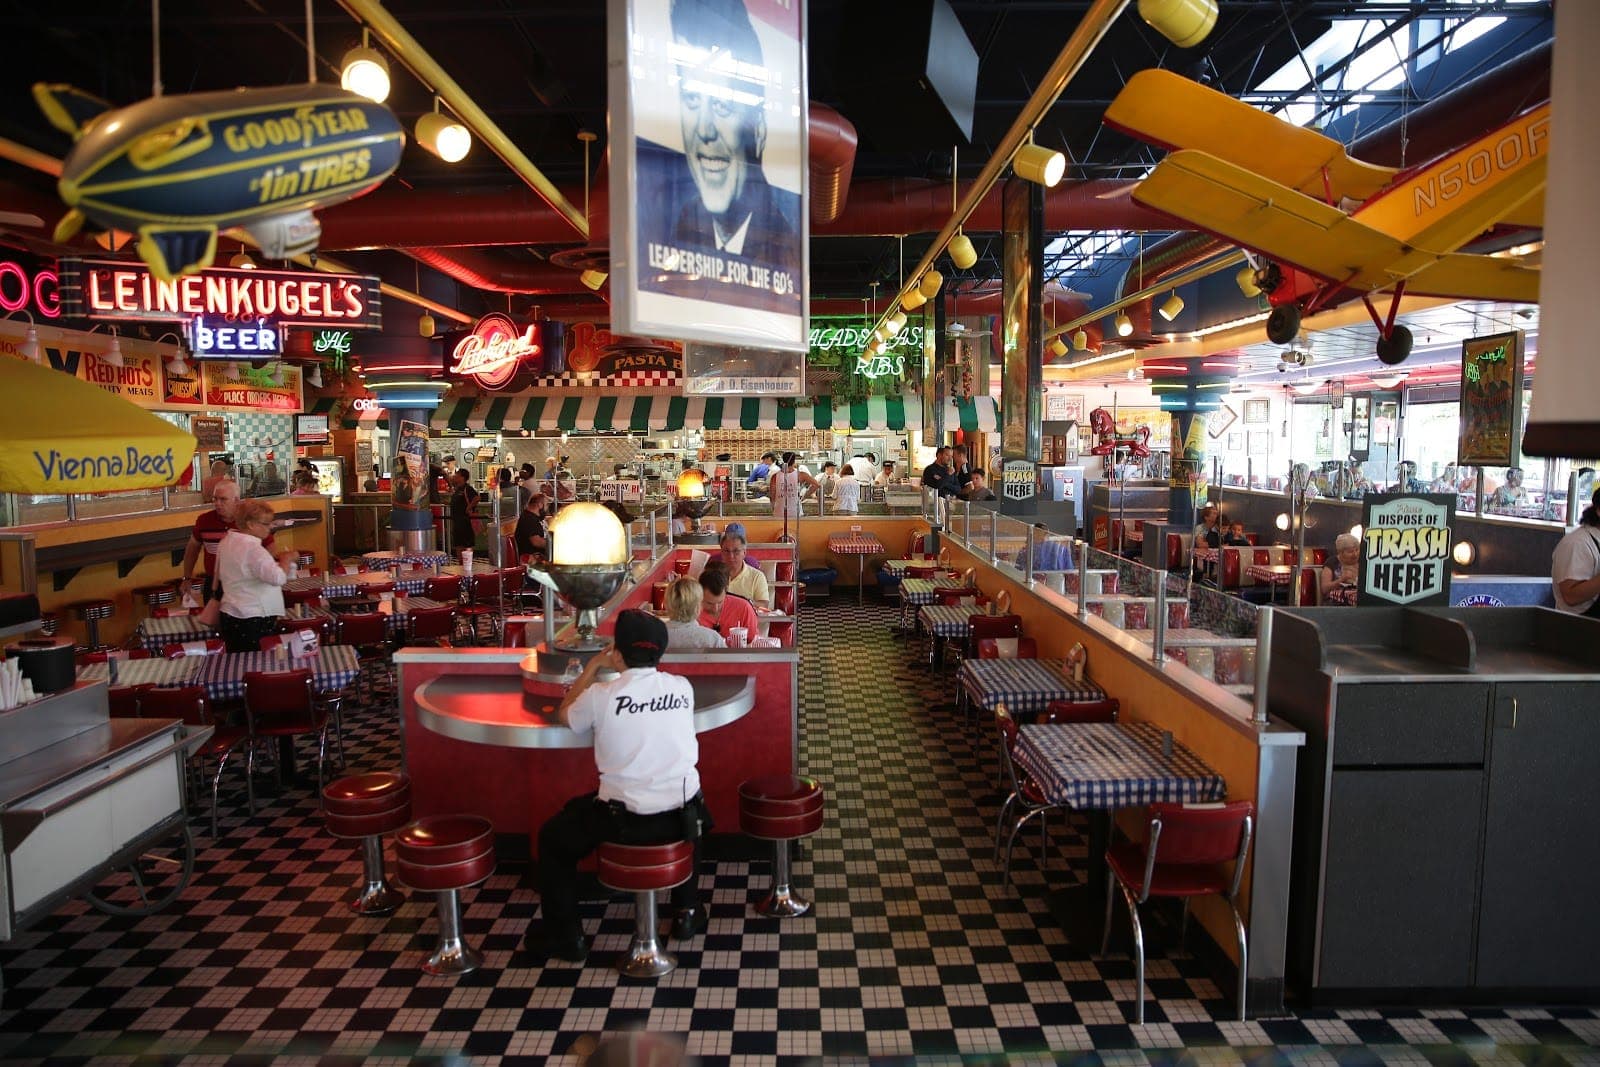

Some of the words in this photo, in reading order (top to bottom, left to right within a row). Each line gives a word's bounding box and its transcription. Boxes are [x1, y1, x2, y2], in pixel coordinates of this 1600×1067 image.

[224, 107, 369, 152] GOODYEAR
[300, 148, 372, 194] TIRES
[648, 242, 724, 280] LEADERSHIP
[727, 260, 749, 286] FOR
[751, 265, 771, 290] THE
[88, 269, 363, 319] LEINENKUGEL'S
[196, 326, 277, 351] BEER
[84, 351, 115, 382] RED
[117, 358, 154, 387] HOTS
[615, 354, 668, 370] PASTA
[853, 355, 906, 379] RIBS
[127, 386, 154, 396] MEATS
[223, 390, 246, 405] PLACE
[246, 391, 272, 406] ORDERS
[741, 378, 794, 394] Eisenhower
[33, 450, 124, 482] Vienna
[126, 446, 175, 482] Beef
[1003, 470, 1035, 484] TRASH
[1006, 484, 1032, 498] HERE
[1378, 514, 1424, 526] DISPOSE
[1425, 514, 1440, 525] OF
[1364, 525, 1451, 561] TRASH
[1373, 563, 1436, 598] HERE
[615, 694, 689, 716] Portillo's
